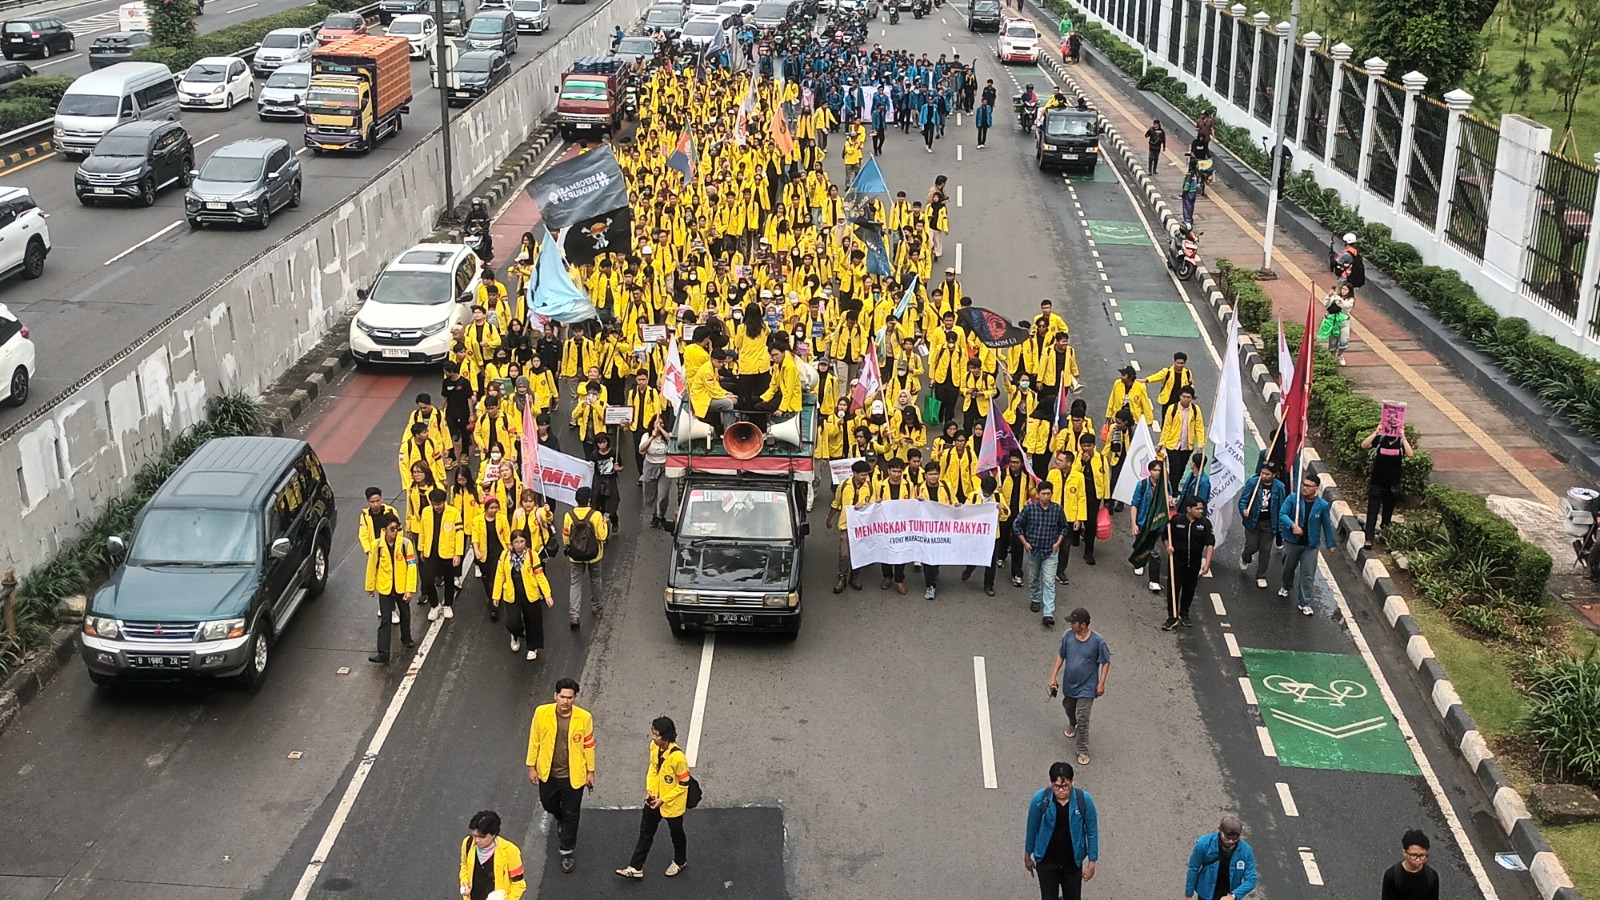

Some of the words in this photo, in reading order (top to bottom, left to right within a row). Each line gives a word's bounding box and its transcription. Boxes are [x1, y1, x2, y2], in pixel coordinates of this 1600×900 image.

[854, 520, 906, 538] MENANGKAN
[909, 519, 951, 534] TUNTUTAN
[953, 521, 991, 535] RAKYAT!
[137, 656, 143, 664] B
[169, 657, 179, 665] ZR
